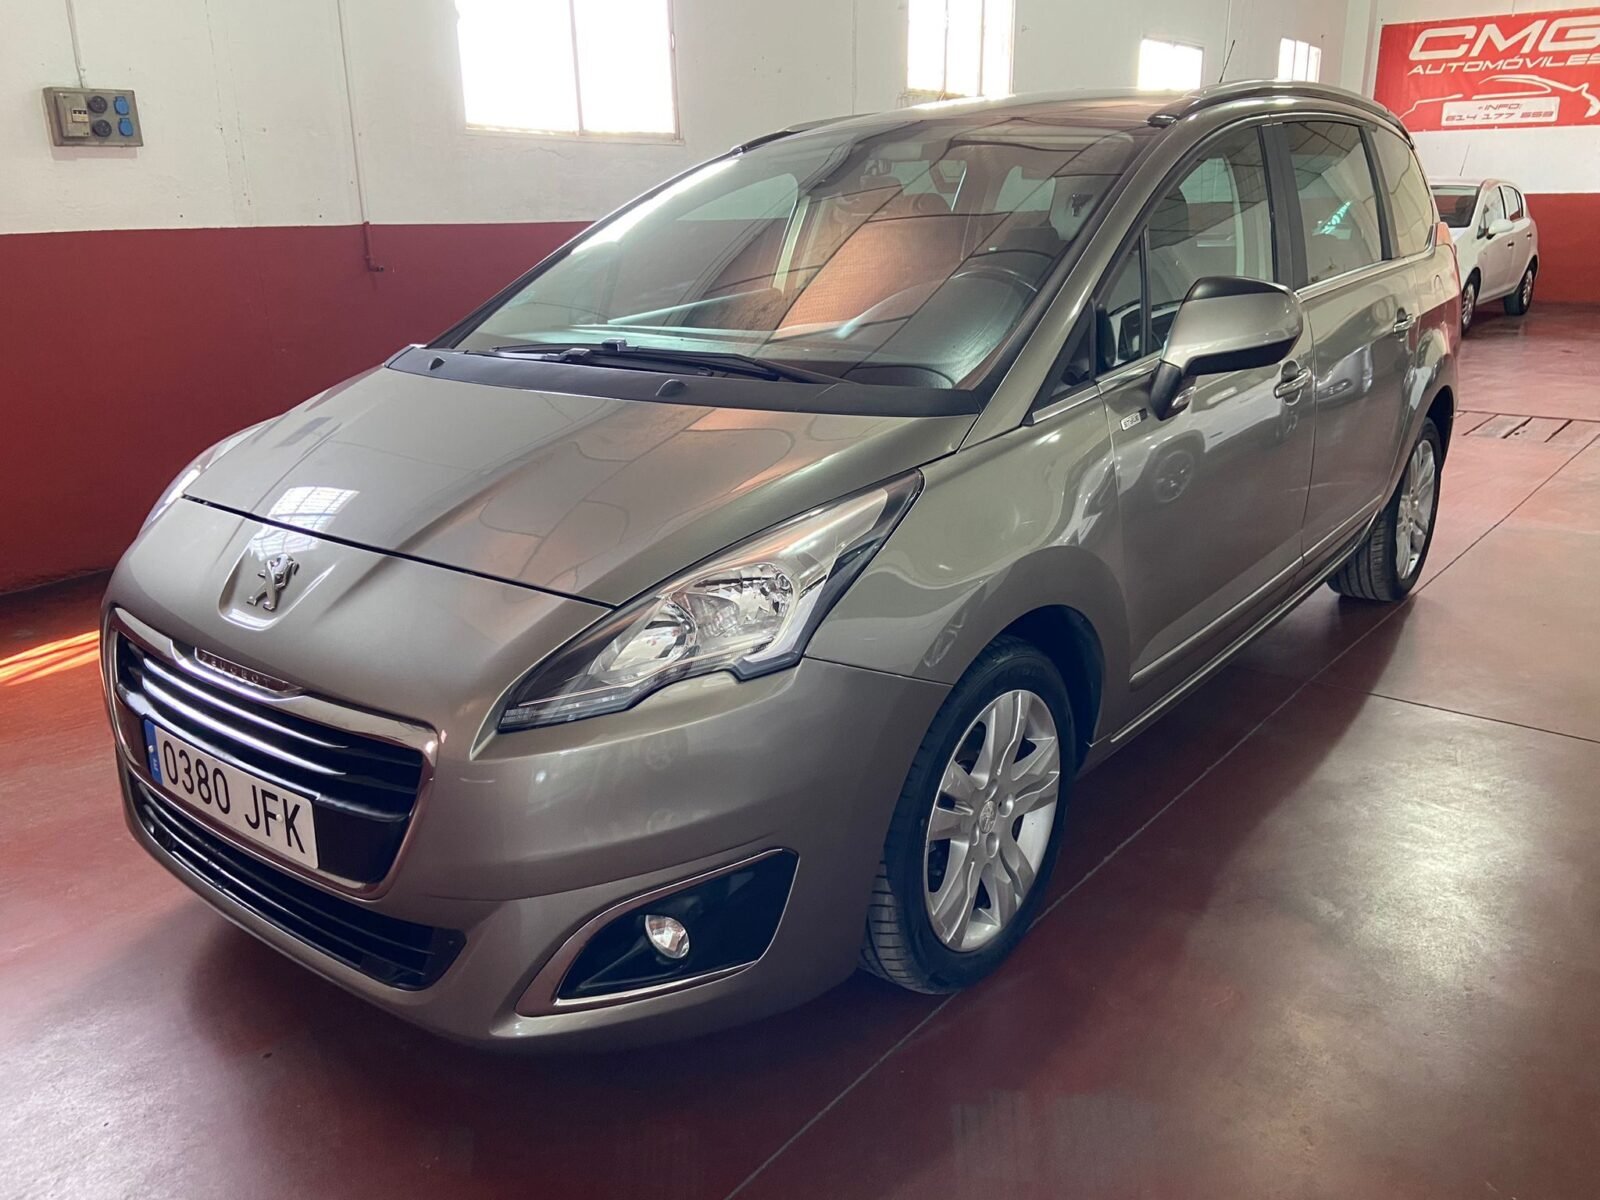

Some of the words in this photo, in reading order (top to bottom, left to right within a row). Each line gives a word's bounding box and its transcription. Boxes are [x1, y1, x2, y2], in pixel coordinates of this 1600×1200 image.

[1408, 15, 1600, 61] CMG
[1407, 52, 1600, 76] AUTOMÓVILES
[1445, 113, 1477, 122] 614
[1481, 112, 1515, 120] 177
[163, 740, 231, 815] 0380
[244, 785, 306, 854] JFK
